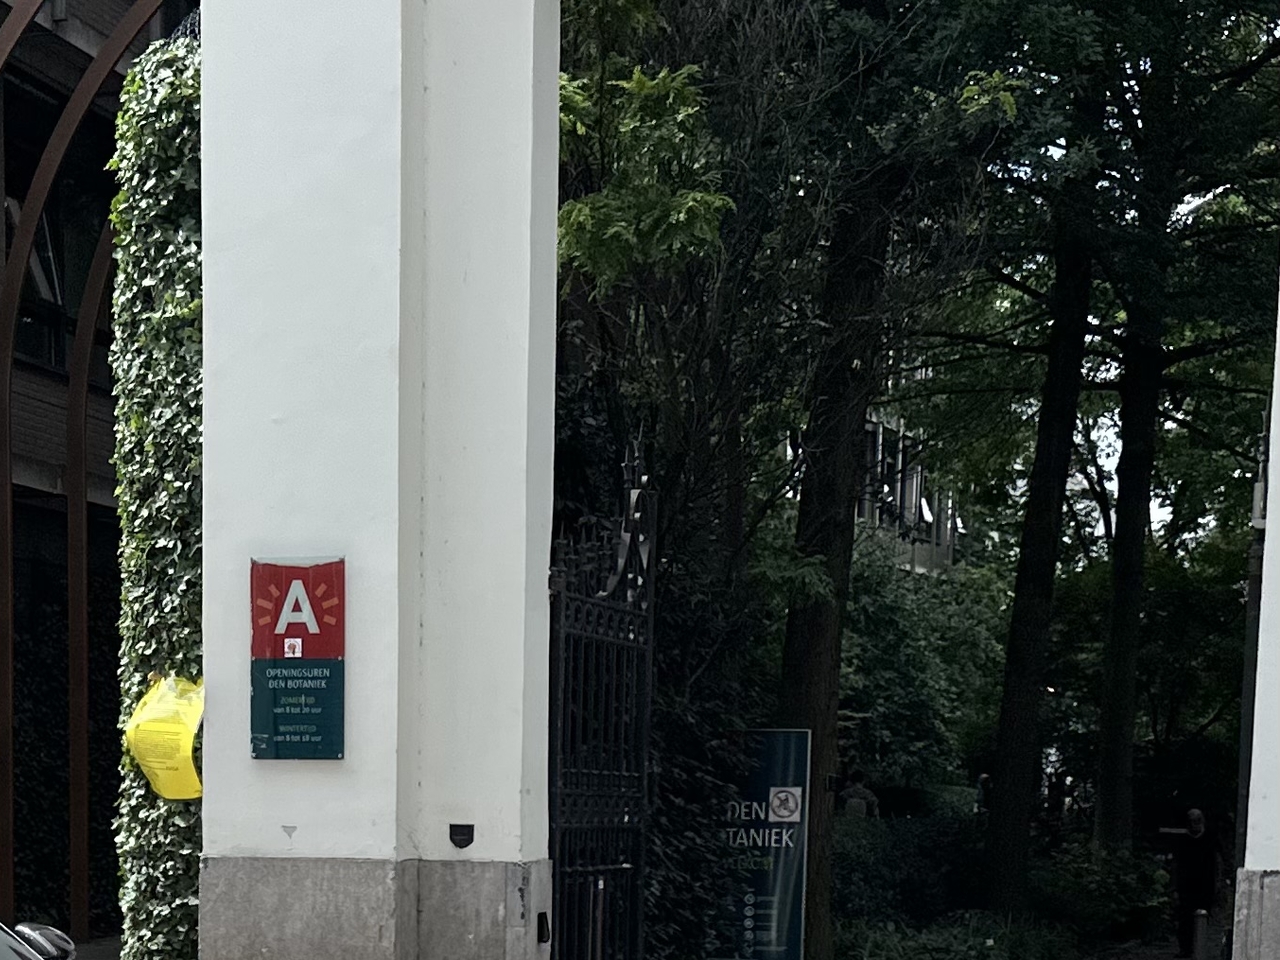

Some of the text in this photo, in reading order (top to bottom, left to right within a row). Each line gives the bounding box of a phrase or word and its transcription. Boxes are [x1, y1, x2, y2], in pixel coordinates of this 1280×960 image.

[273, 579, 320, 634] A
[266, 668, 330, 678] OPENINGSUREN
[268, 680, 327, 689] DEN BOTANIEK
[726, 801, 767, 821] DEN
